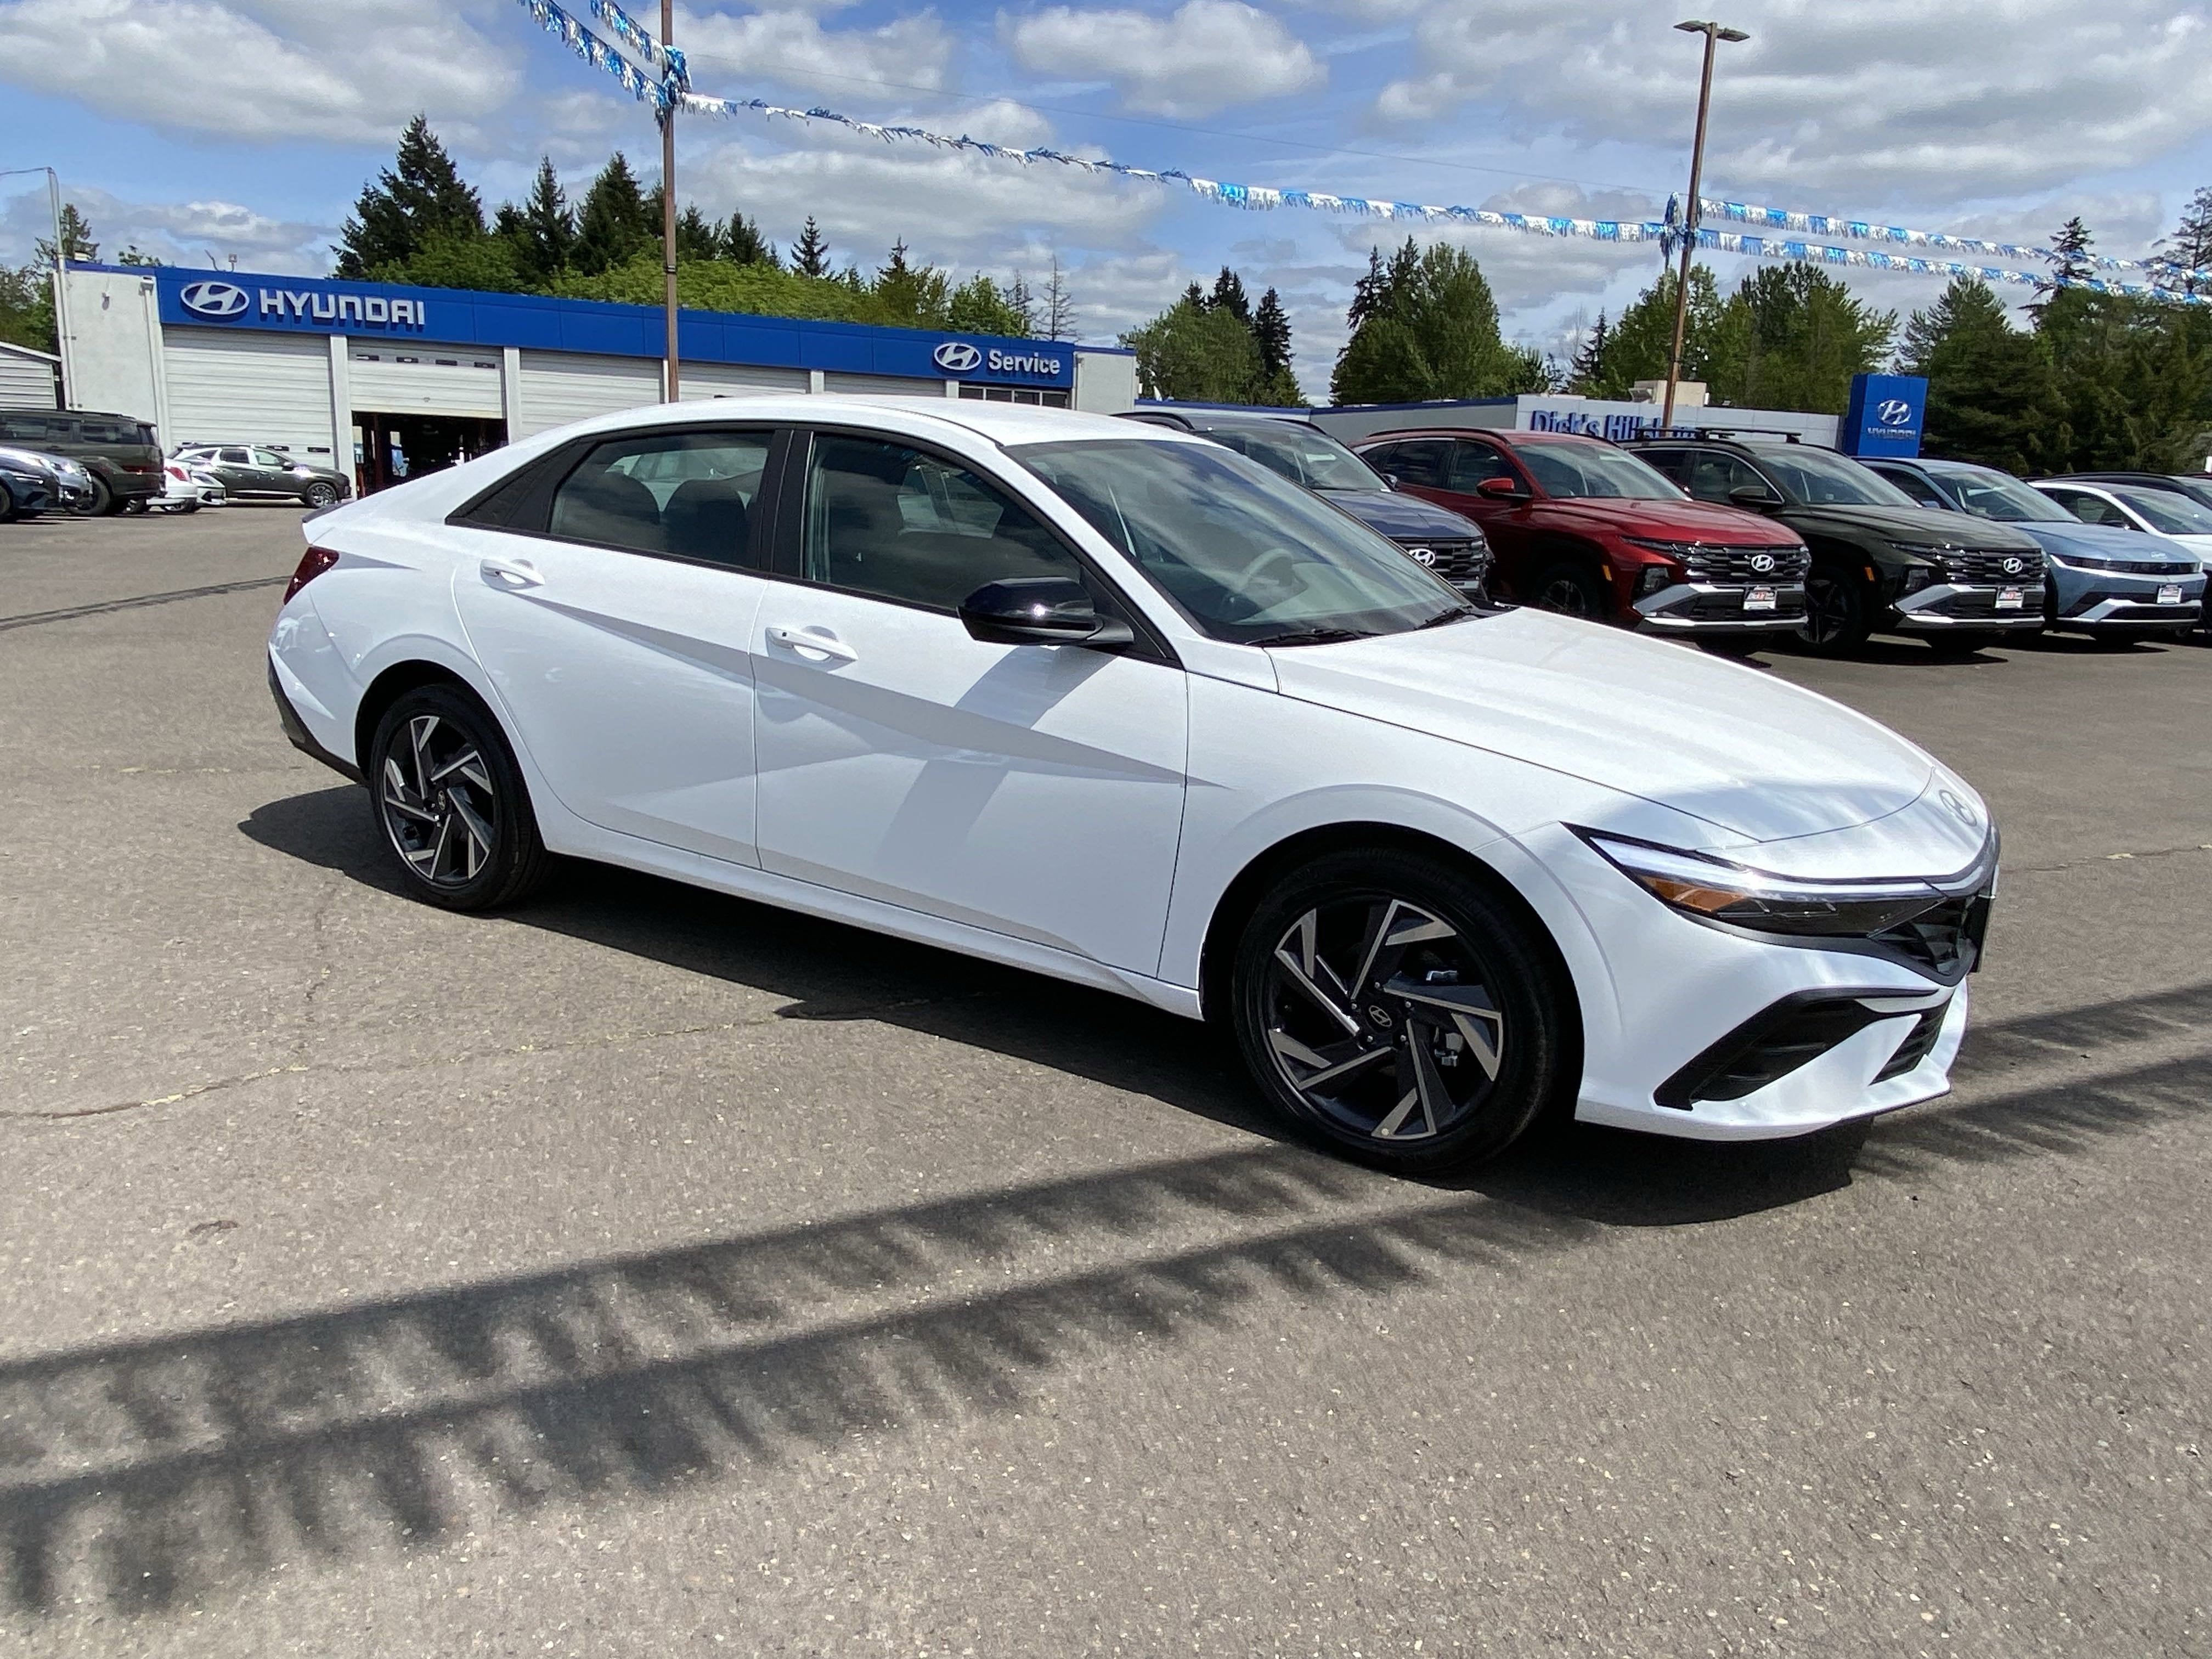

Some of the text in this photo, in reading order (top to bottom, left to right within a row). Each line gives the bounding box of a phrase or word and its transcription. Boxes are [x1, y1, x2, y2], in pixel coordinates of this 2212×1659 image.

[259, 288, 425, 325] HYUNDAI
[988, 348, 1060, 374] Service
[1530, 410, 1600, 438] Dick's
